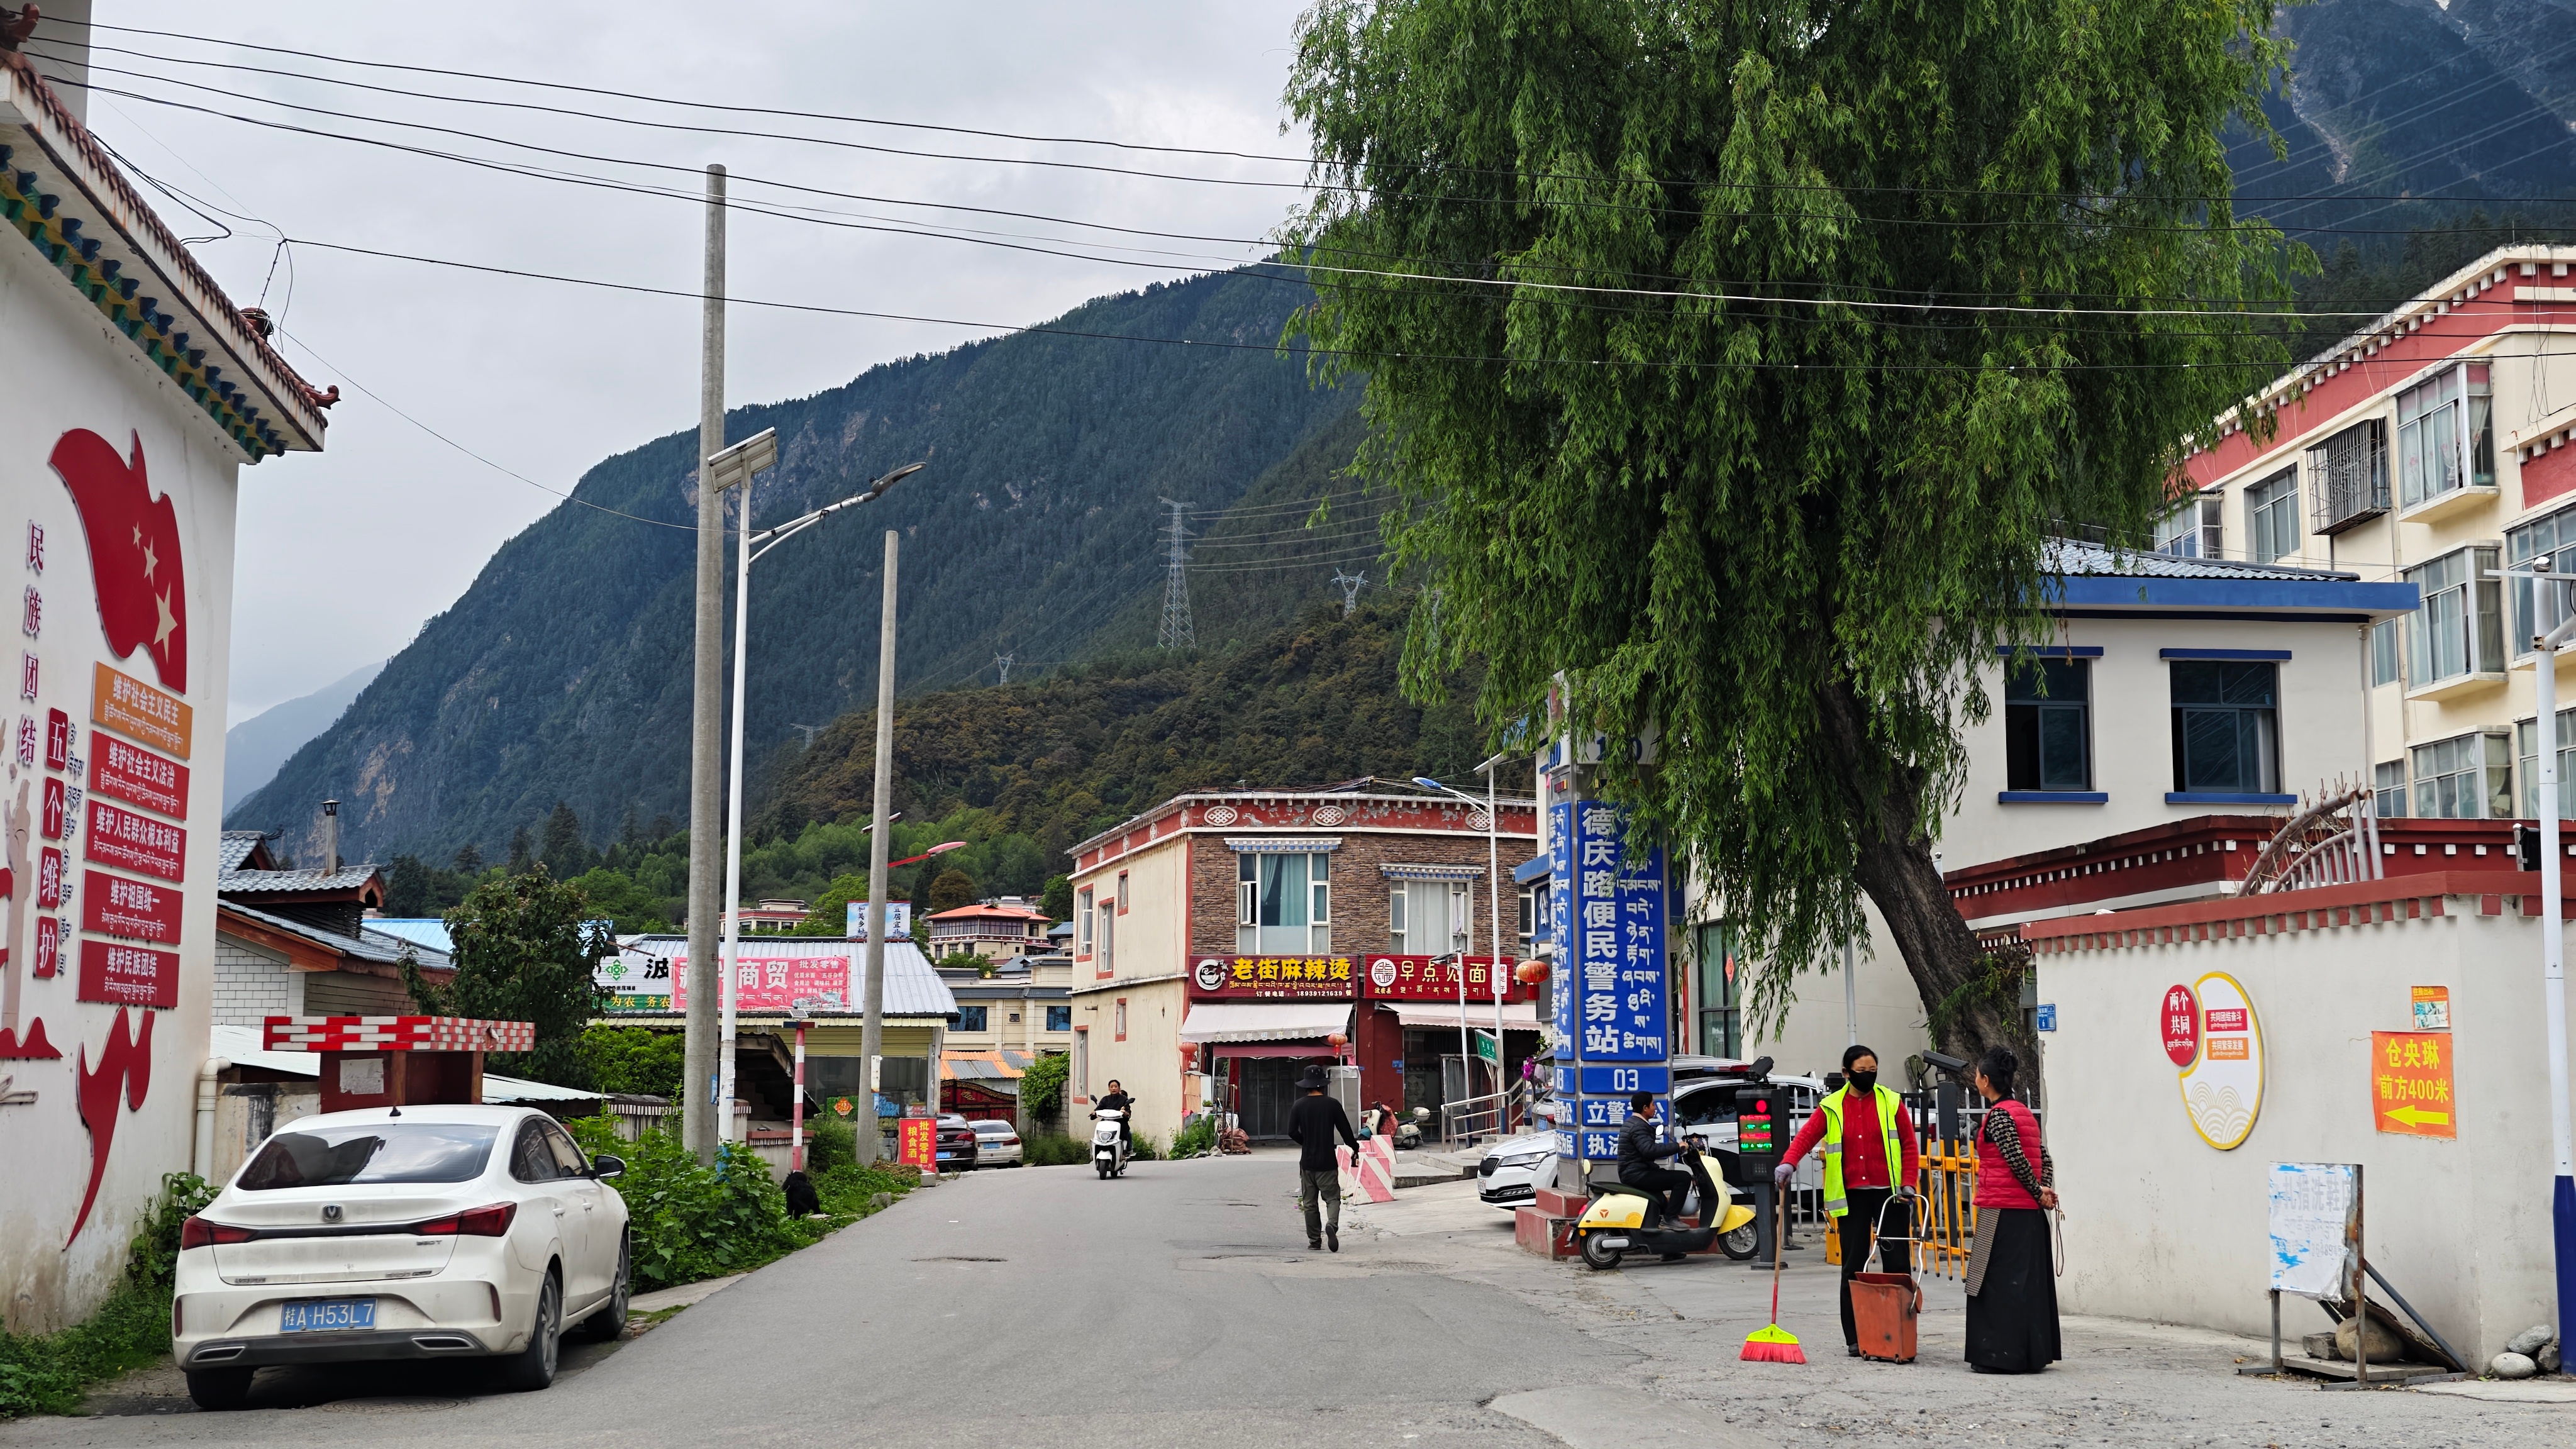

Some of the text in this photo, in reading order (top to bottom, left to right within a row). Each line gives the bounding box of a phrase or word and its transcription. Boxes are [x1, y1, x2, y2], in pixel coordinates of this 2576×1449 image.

[17, 519, 44, 765] 民族团结
[113, 674, 179, 726] 维护社会主义民主
[109, 741, 175, 789] 维护社会主义法治
[39, 719, 65, 969] 五个维护
[96, 806, 179, 854] 维护人民群众根本利益
[111, 879, 160, 913] 维护祖国统一
[1582, 808, 1618, 1053] 德庆路便民警务站
[107, 947, 157, 978] 维护民族团结
[799, 960, 839, 969] 批发零售
[1231, 957, 1352, 980] 老街麻辣烫
[611, 996, 635, 1008] 为农
[2169, 991, 2189, 1011] 两个
[2170, 1015, 2190, 1035] 共同
[2210, 1011, 2242, 1022] 共同团结奋斗
[2212, 1040, 2243, 1050] 共同繁荣发展
[2385, 1038, 2440, 1070] 仓央琳
[1556, 1069, 1563, 1091] 03
[1614, 1069, 1638, 1091] 03
[2379, 1074, 2449, 1104] 前方400米
[908, 1126, 917, 1158] 粮食酒
[919, 1121, 929, 1163] 批发零售
[286, 1304, 374, 1326] 桂A·H53L7
